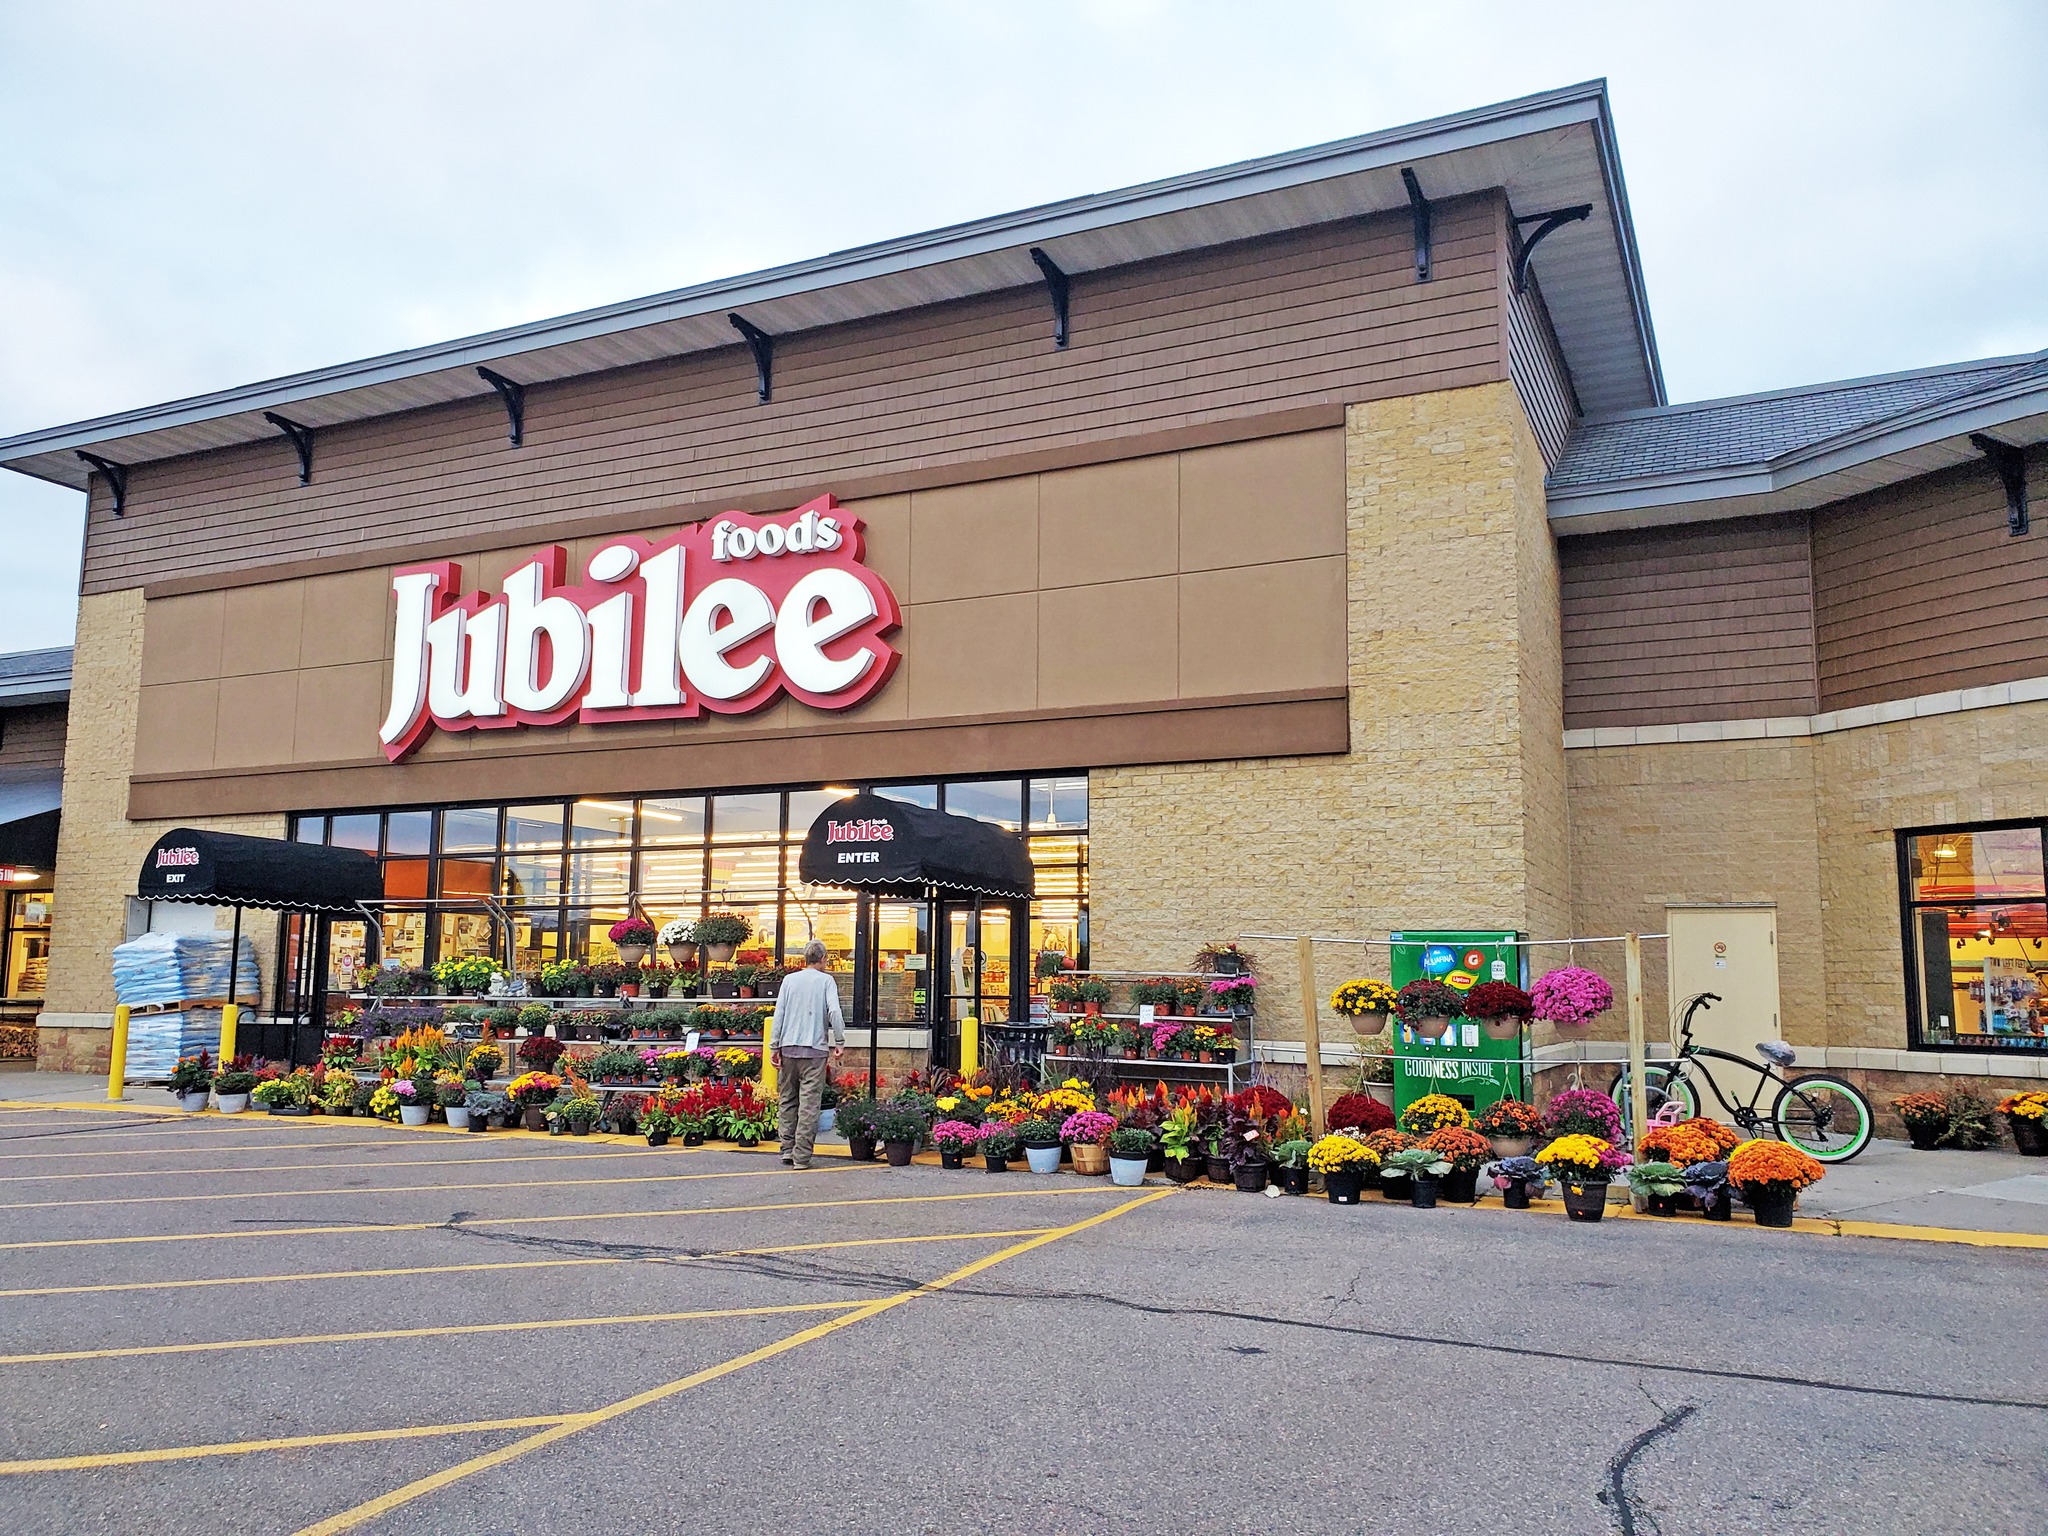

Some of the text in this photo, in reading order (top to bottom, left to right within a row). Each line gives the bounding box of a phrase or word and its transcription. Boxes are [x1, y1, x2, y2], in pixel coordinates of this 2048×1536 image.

[711, 510, 842, 562] foods
[379, 543, 881, 746] Jubilee
[826, 819, 894, 845] Jubilee
[156, 847, 199, 868] Jubilee
[837, 852, 880, 864] ENTER
[166, 873, 186, 883] EXIT
[1468, 954, 1478, 965] G
[1452, 976, 1470, 984] Lipton
[1404, 1059, 1495, 1079] GOODNESS INSIDE
